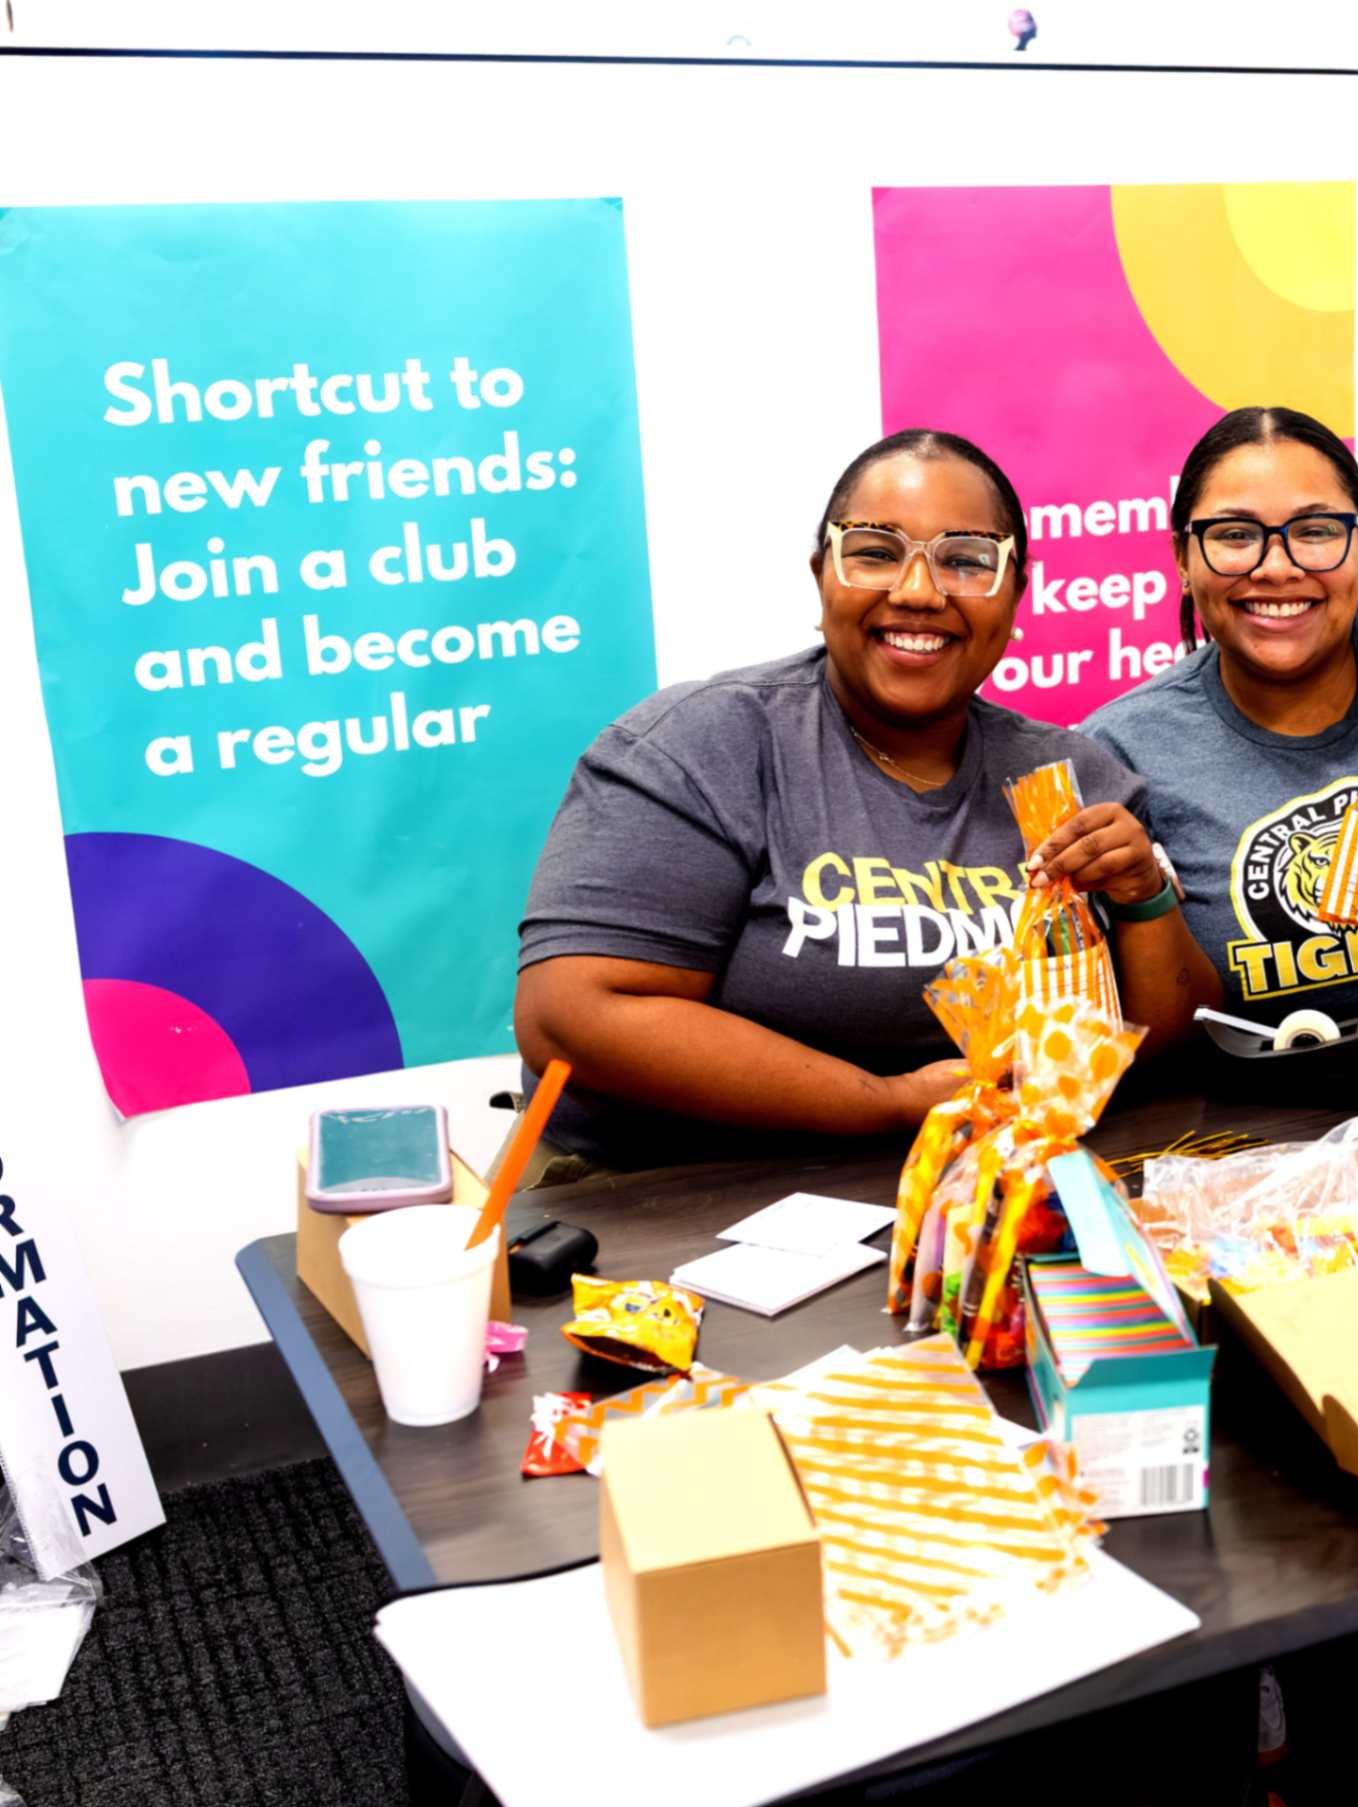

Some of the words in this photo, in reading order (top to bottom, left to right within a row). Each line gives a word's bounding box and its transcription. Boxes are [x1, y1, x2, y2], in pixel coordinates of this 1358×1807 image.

[105, 358, 433, 426] Shortcut
[450, 357, 524, 410] to
[114, 467, 281, 516] new
[301, 431, 577, 503] friends:
[1023, 475, 1180, 540] mem
[122, 537, 278, 605] Join
[300, 550, 347, 590] a
[369, 518, 516, 585] club
[1032, 561, 1167, 621] keep
[135, 618, 282, 691] and
[303, 614, 580, 674] become
[979, 650, 1094, 692] our
[1109, 628, 1208, 680] he
[145, 736, 193, 776] a
[218, 692, 490, 777] regular
[803, 852, 1028, 915] CENTR
[1247, 806, 1327, 901] CENTRAL
[782, 896, 1026, 967] PIEDM
[0, 1157, 117, 1537] RMATION
